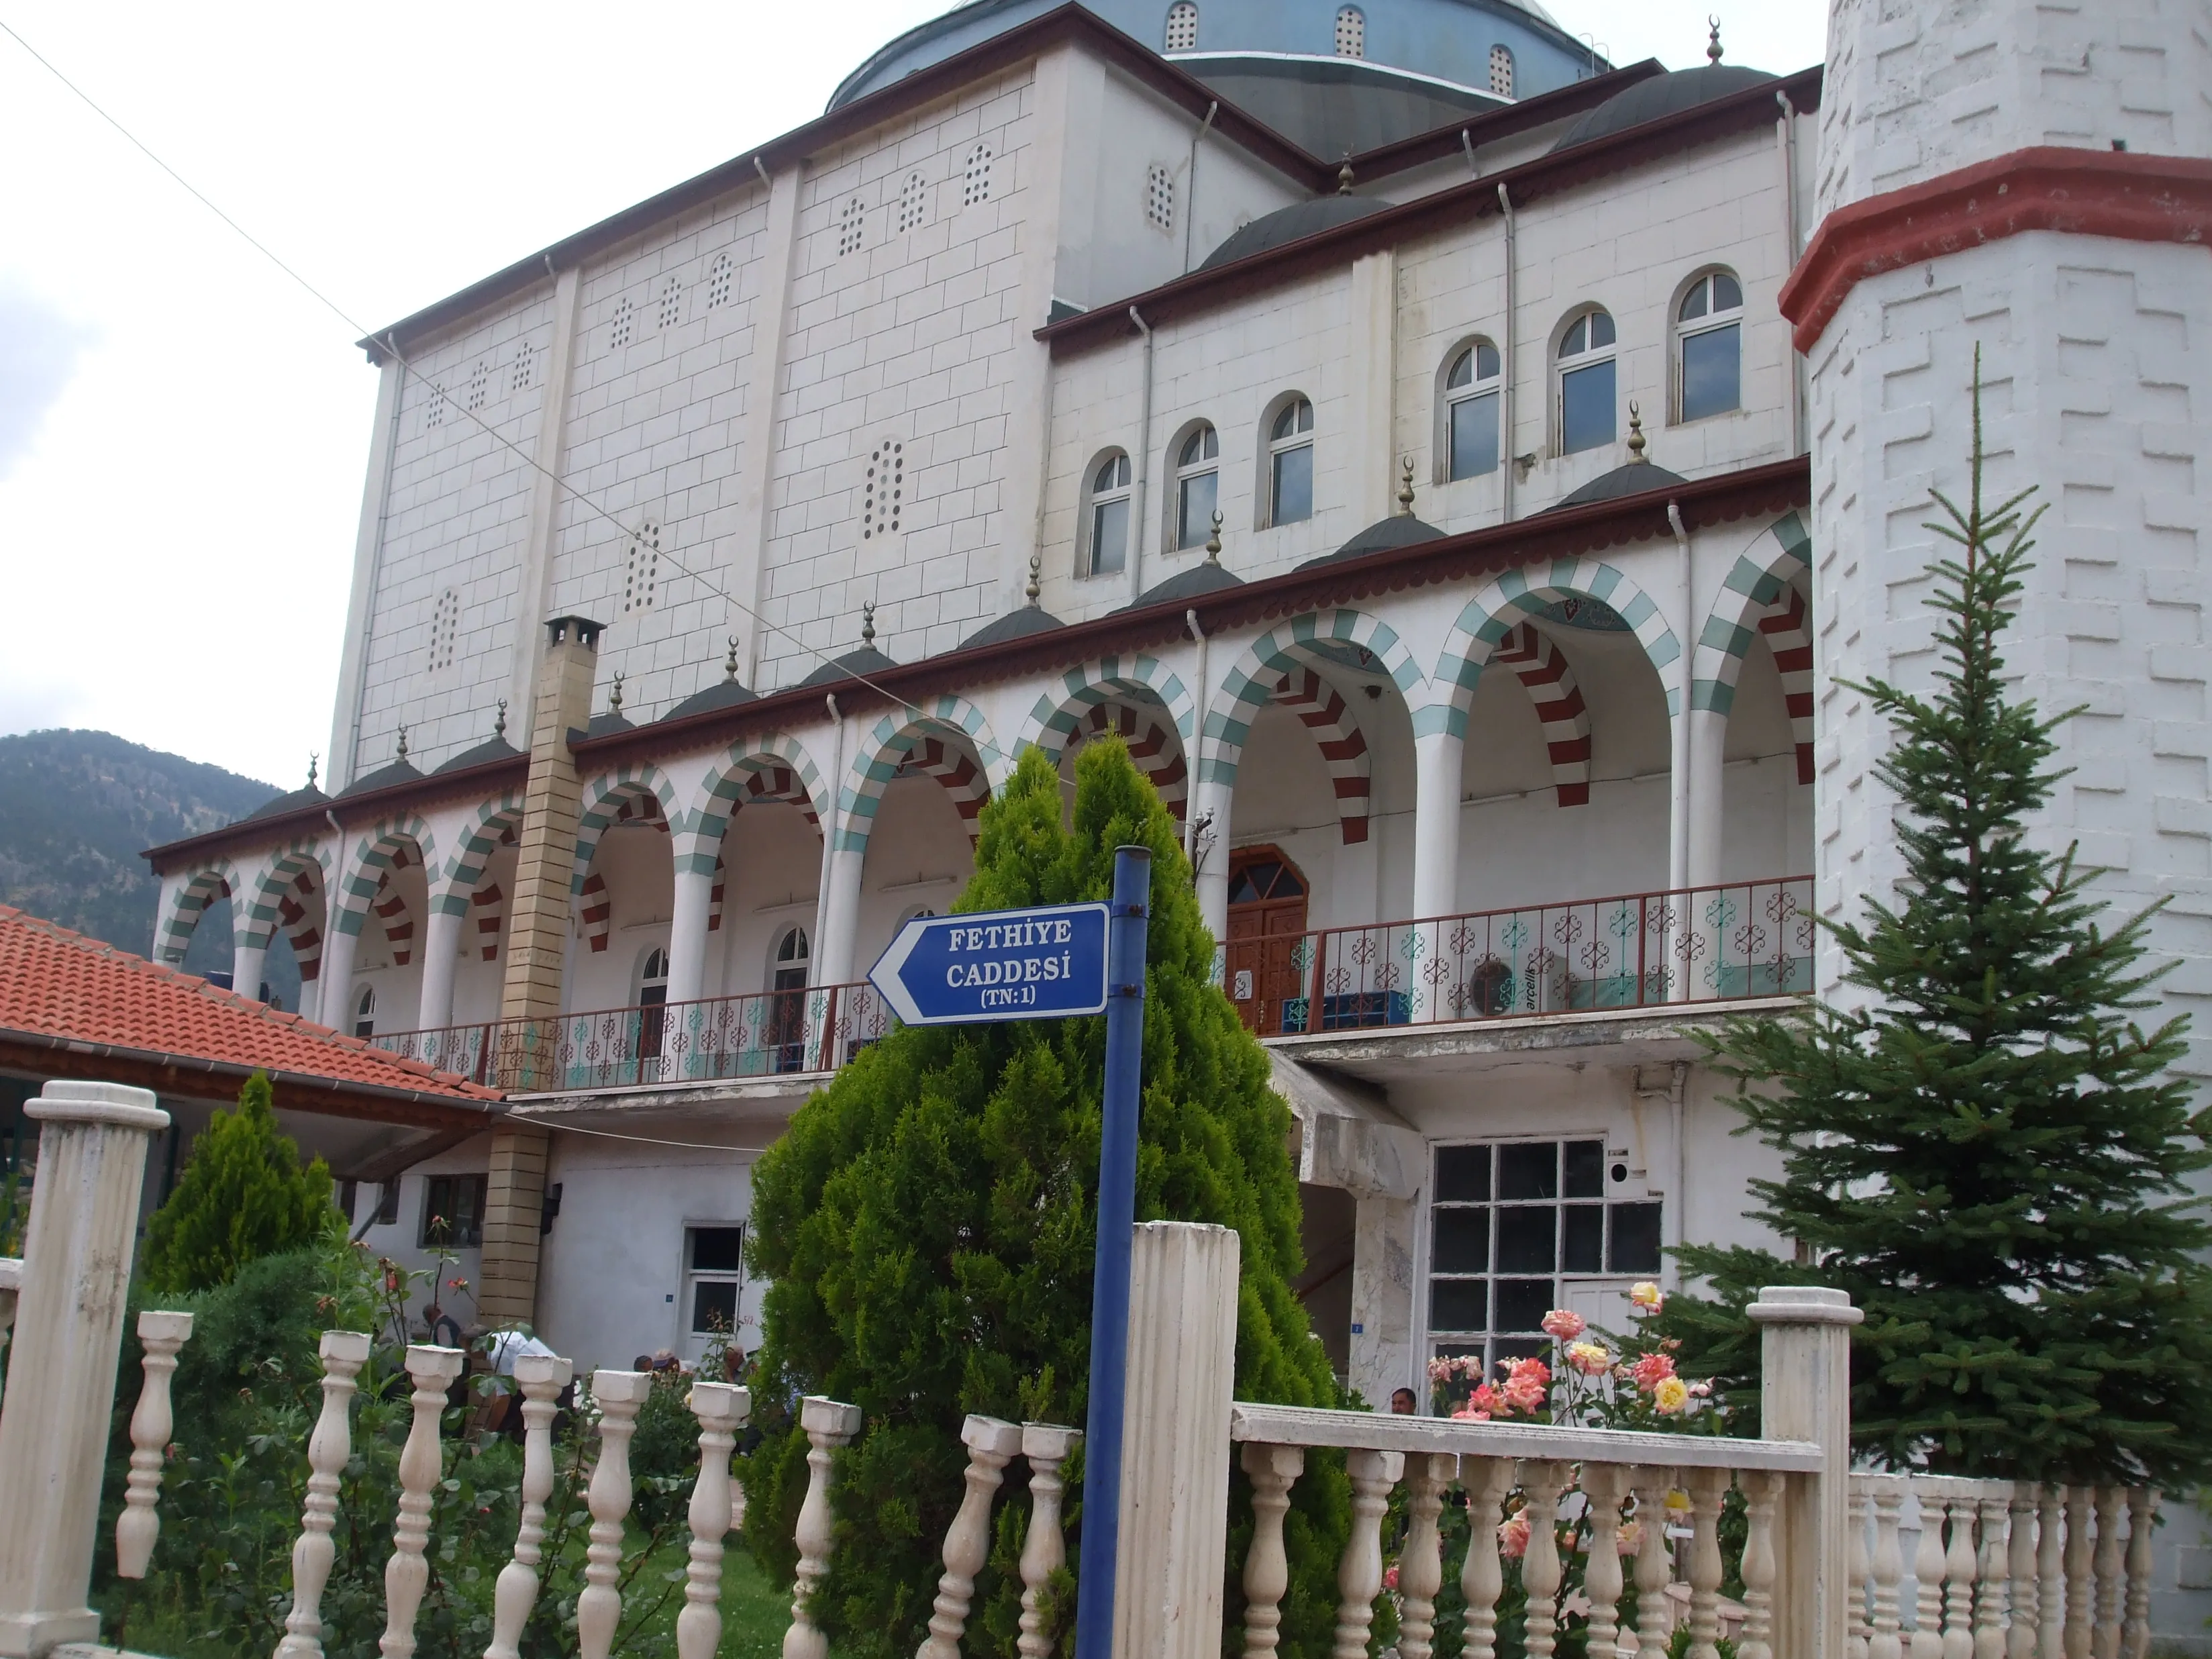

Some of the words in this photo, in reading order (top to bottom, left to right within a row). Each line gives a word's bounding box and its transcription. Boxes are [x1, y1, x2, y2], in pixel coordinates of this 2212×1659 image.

[949, 918, 1072, 952] FETHİYE
[947, 950, 1071, 988] CADDESİ
[981, 985, 1036, 1009] (TN:1)
[1525, 967, 1538, 1010] arçelik
